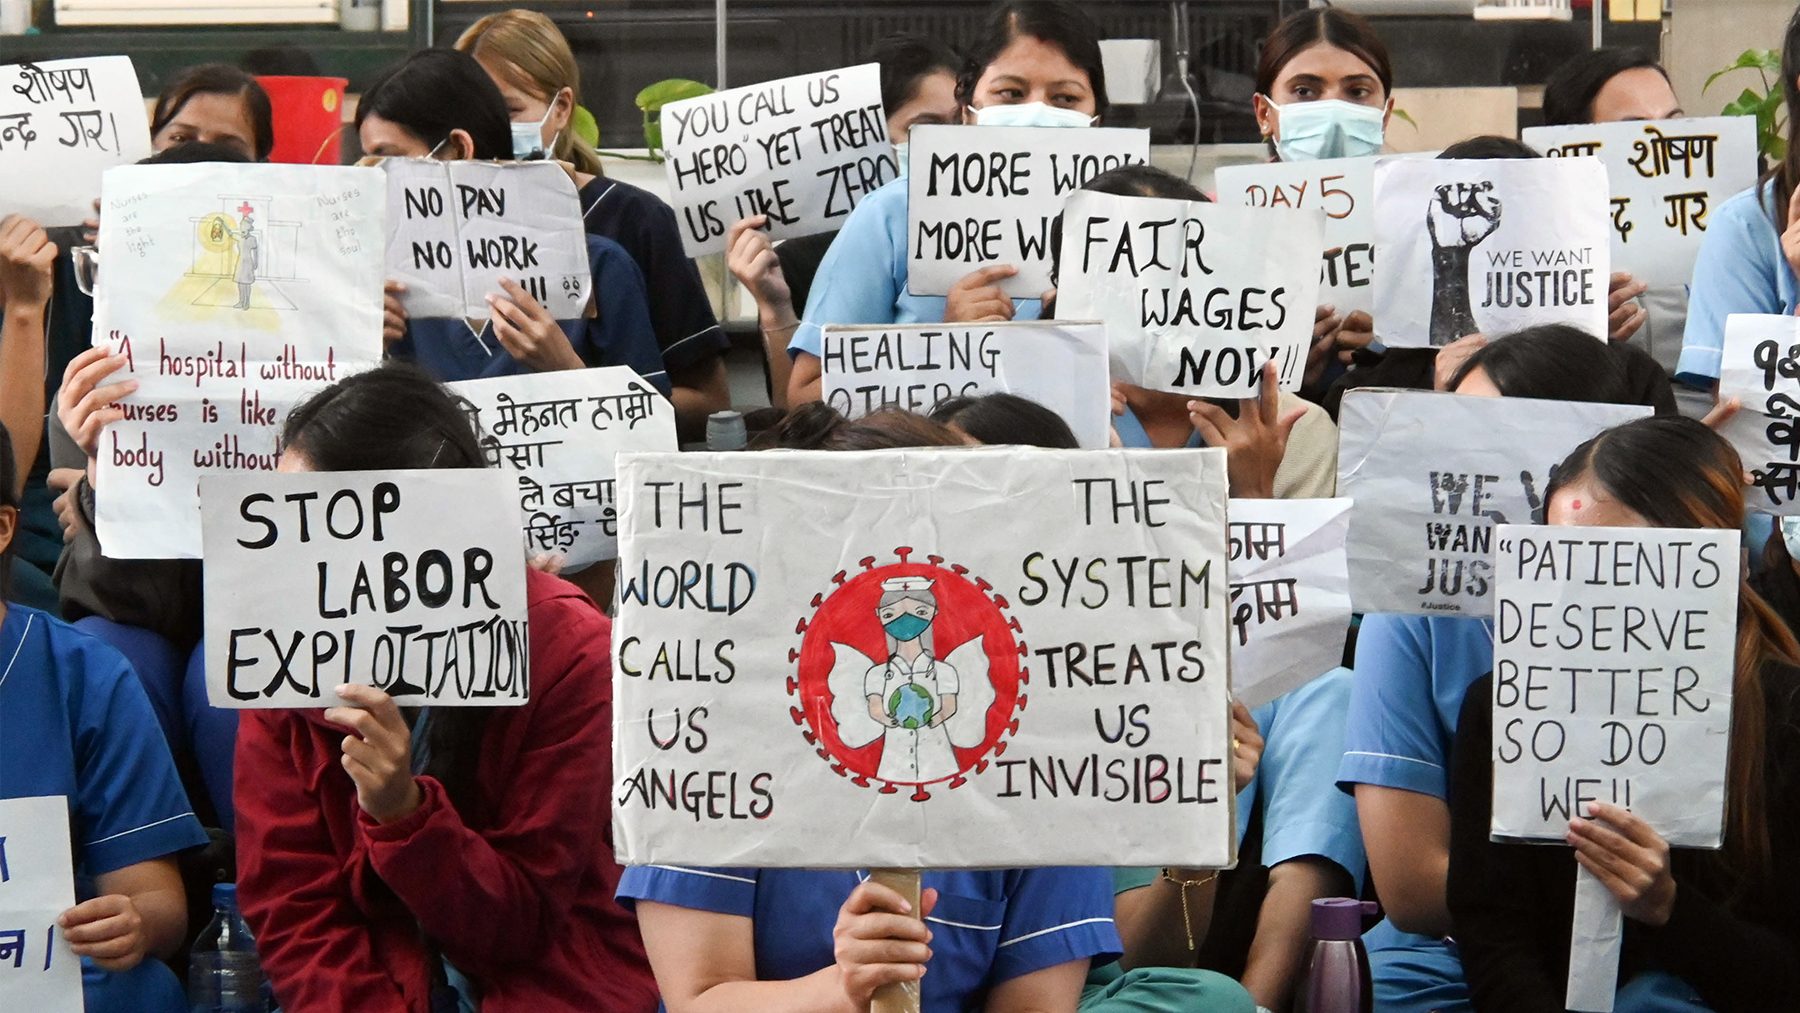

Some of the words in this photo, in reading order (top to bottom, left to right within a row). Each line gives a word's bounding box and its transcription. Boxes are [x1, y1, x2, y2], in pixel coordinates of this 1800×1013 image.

[12, 62, 96, 104] शोषण
[672, 100, 729, 145] YOU
[739, 85, 795, 126] CALL
[808, 74, 840, 108] US
[757, 126, 802, 170] YET
[811, 104, 886, 154] TREAT
[1627, 126, 1719, 178] शोषण
[317, 188, 360, 207] Nurses
[684, 200, 725, 243] US
[816, 154, 899, 218] ZERO
[926, 152, 1031, 197] MORE
[1049, 153, 1145, 196] WO
[1245, 180, 1307, 208] DAY
[1319, 175, 1355, 219] 5
[110, 191, 148, 210] Nurses
[122, 211, 138, 224] are
[330, 209, 350, 222] are
[404, 187, 443, 219] NO
[456, 184, 505, 219] PAY
[126, 226, 141, 238] the
[127, 237, 155, 258] light
[340, 241, 361, 256] soul
[412, 241, 452, 270] NO
[466, 235, 538, 271] WORK
[914, 217, 1001, 262] MORE
[1083, 217, 1214, 278] FAIR
[1487, 250, 1523, 268] WE
[1530, 247, 1593, 266] WANT
[1141, 287, 1286, 331] WAGES
[1481, 268, 1595, 309] JUSTICE
[160, 338, 246, 388] hospital
[259, 344, 336, 380] without
[823, 331, 1001, 379] HEALING
[202, 398, 218, 423] is
[241, 387, 277, 426] like
[493, 393, 583, 436] मेहनत
[113, 431, 164, 487] body
[194, 434, 282, 471] without
[237, 482, 401, 550] STOP
[644, 482, 743, 534] THE
[1071, 478, 1170, 527] THE
[1429, 471, 1507, 522] WE
[1425, 521, 1491, 554] WAN
[317, 546, 501, 619] LABOR
[619, 556, 757, 616] WORLD
[1019, 552, 1211, 609] SYSTEM
[1500, 538, 1720, 590] "PATIENTS
[1420, 602, 1461, 612] #Justice
[1500, 599, 1709, 653] DESERVE
[226, 614, 529, 702] EXPLOITATION
[618, 636, 735, 684] CALLS
[1035, 641, 1205, 689] TREATS
[1496, 659, 1710, 716] BETTER
[647, 706, 708, 754] US
[1095, 704, 1151, 748] US
[1498, 718, 1566, 765] SO
[1600, 721, 1666, 766] DO
[618, 767, 774, 822] ANGELS
[995, 754, 1222, 805] INVISIBLE
